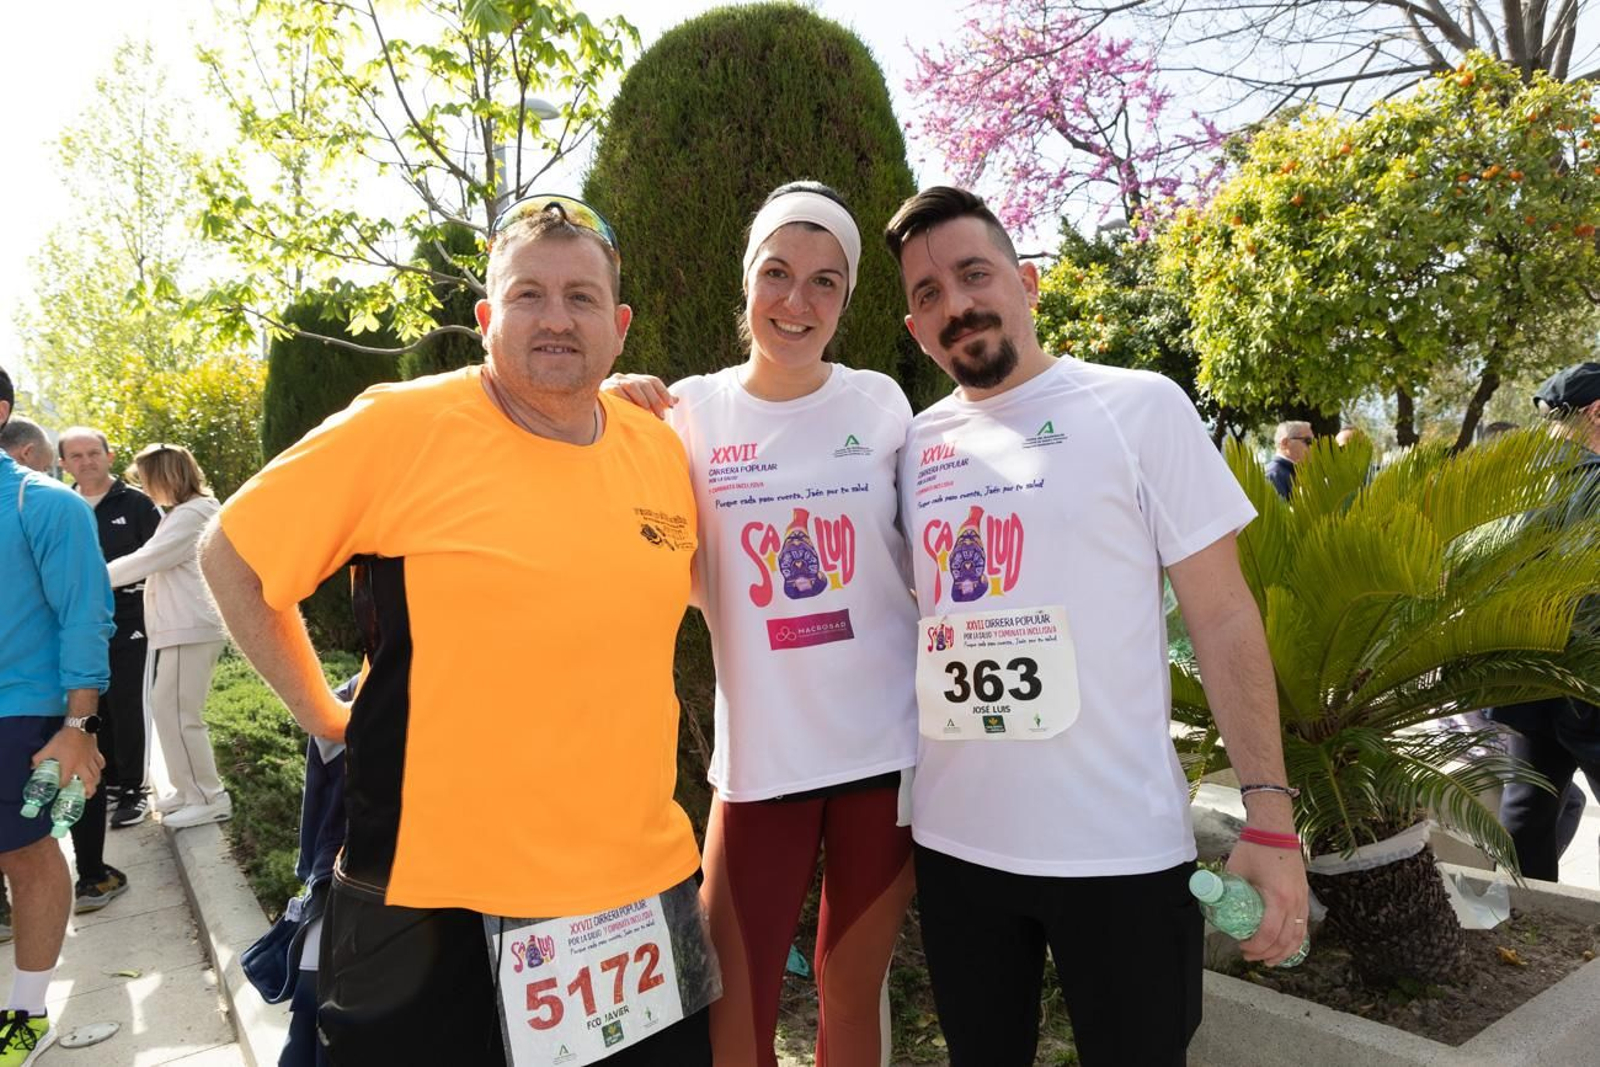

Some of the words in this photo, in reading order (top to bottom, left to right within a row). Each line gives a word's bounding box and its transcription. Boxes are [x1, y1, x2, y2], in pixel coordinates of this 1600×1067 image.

[710, 443, 758, 464] XXVII
[741, 463, 778, 473] POPULAR
[798, 621, 846, 634] MACROSAD
[1015, 614, 1051, 626] POPULAR
[944, 657, 1042, 703] 363
[993, 705, 1011, 713] LUIS
[526, 942, 665, 1030] 5172
[587, 1017, 601, 1030] FCO
[604, 1005, 630, 1023] JAVIER
